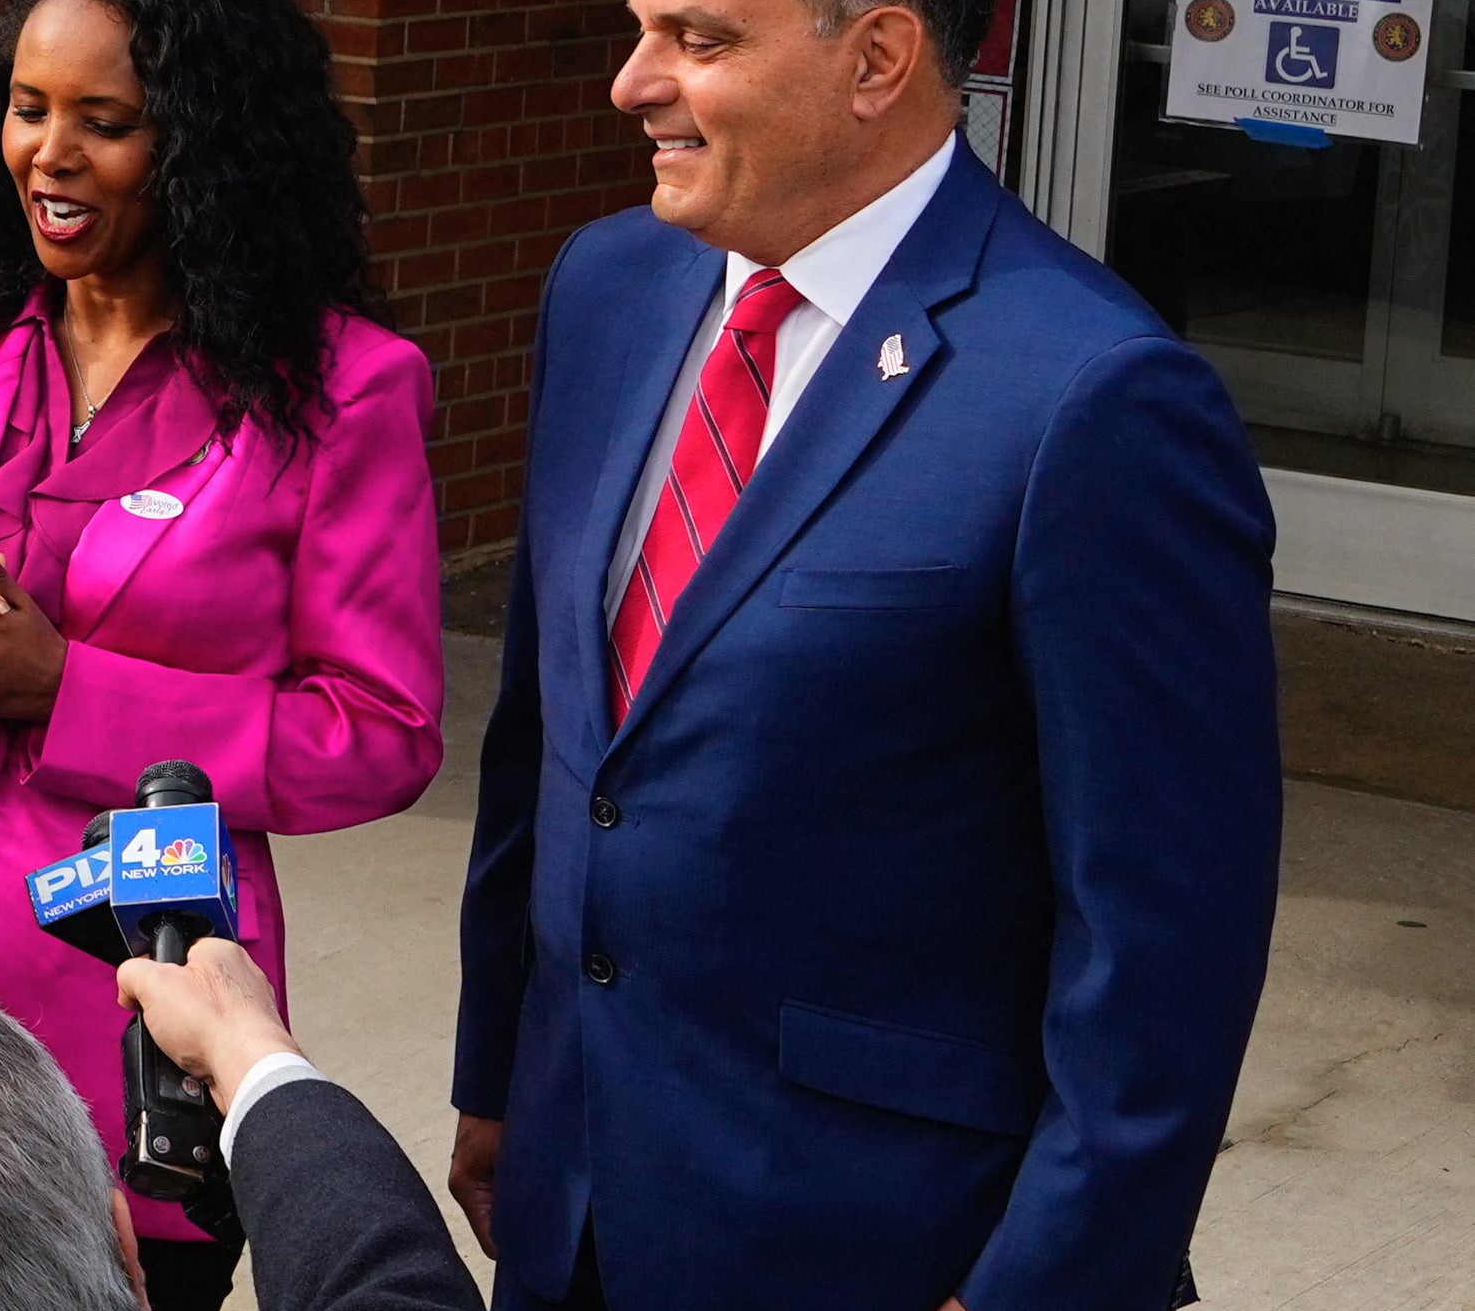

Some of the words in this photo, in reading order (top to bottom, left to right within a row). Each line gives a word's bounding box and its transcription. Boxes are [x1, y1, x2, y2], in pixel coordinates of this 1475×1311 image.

[1197, 83, 1222, 96] SEE
[1225, 86, 1258, 99] POLL
[1261, 90, 1364, 112] COORDINATOR
[1369, 102, 1394, 116] FOR
[1253, 106, 1338, 125] ASSISTANCE
[121, 828, 161, 867] 4
[122, 866, 157, 880] NEW
[161, 863, 207, 877] YORK
[44, 900, 74, 919] NEW
